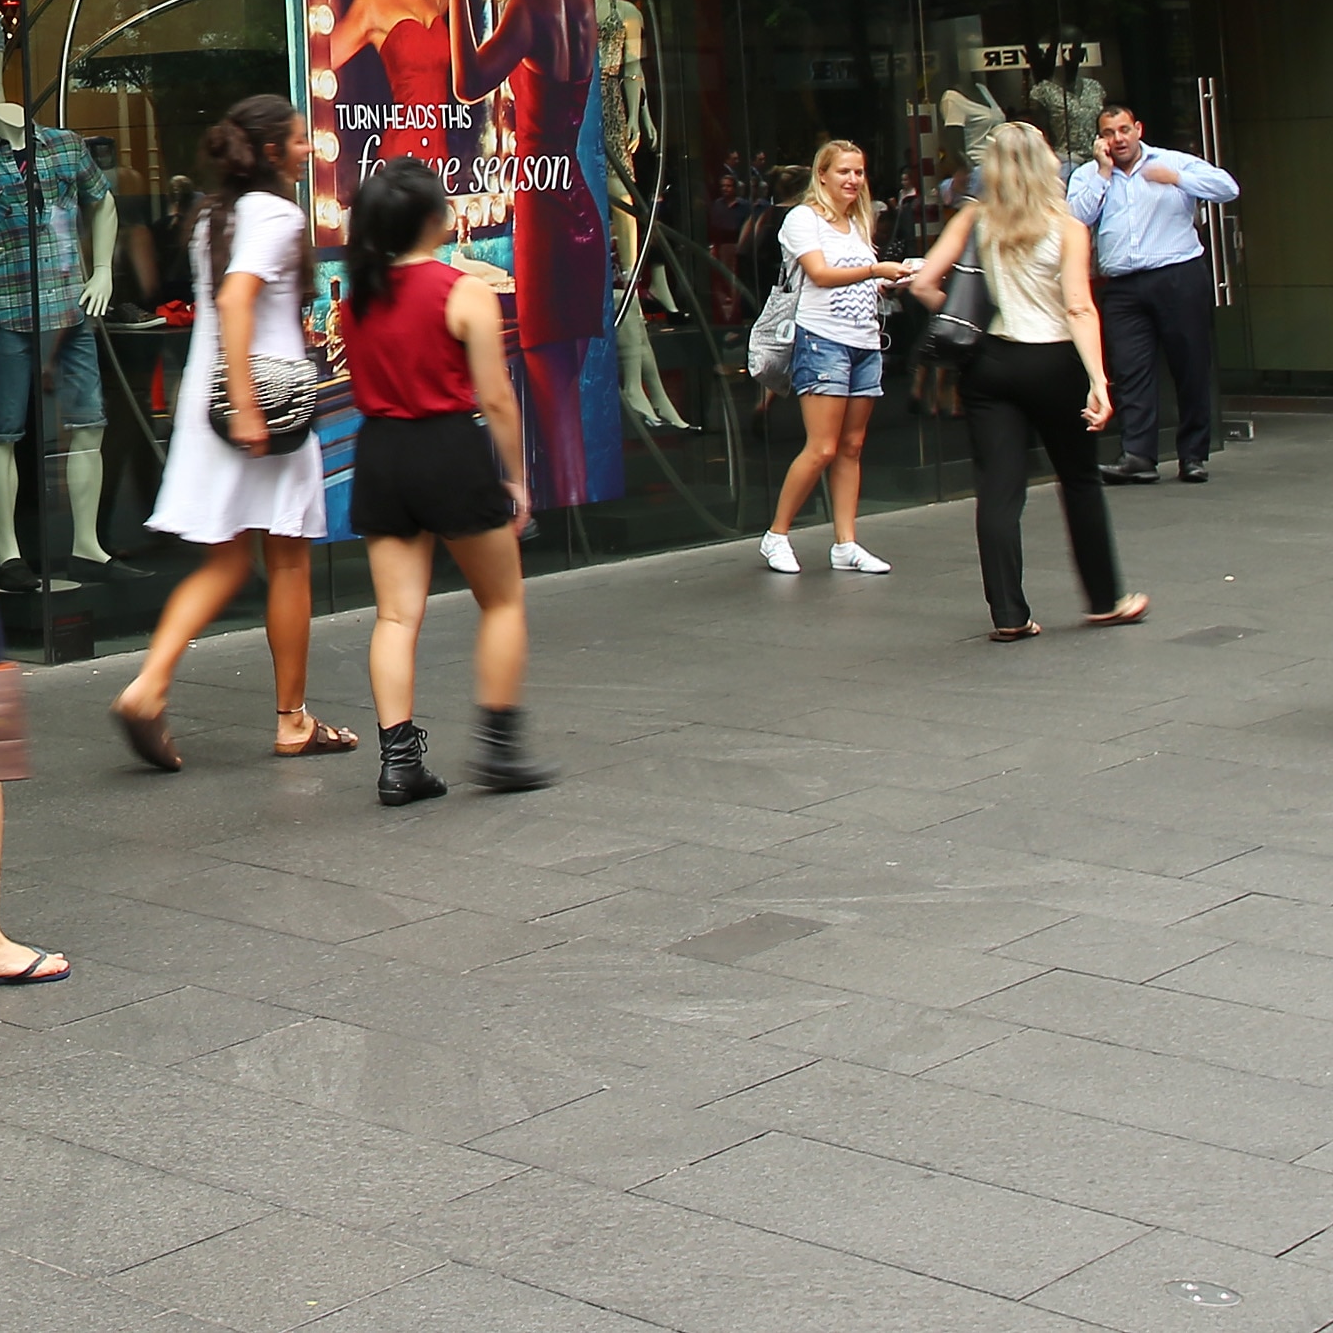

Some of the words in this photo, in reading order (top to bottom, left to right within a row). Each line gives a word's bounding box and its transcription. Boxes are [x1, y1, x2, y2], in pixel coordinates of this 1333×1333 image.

[335, 103, 381, 131] TURN
[383, 103, 437, 130] HEADS
[438, 103, 473, 129] THIS
[468, 153, 573, 194] season
